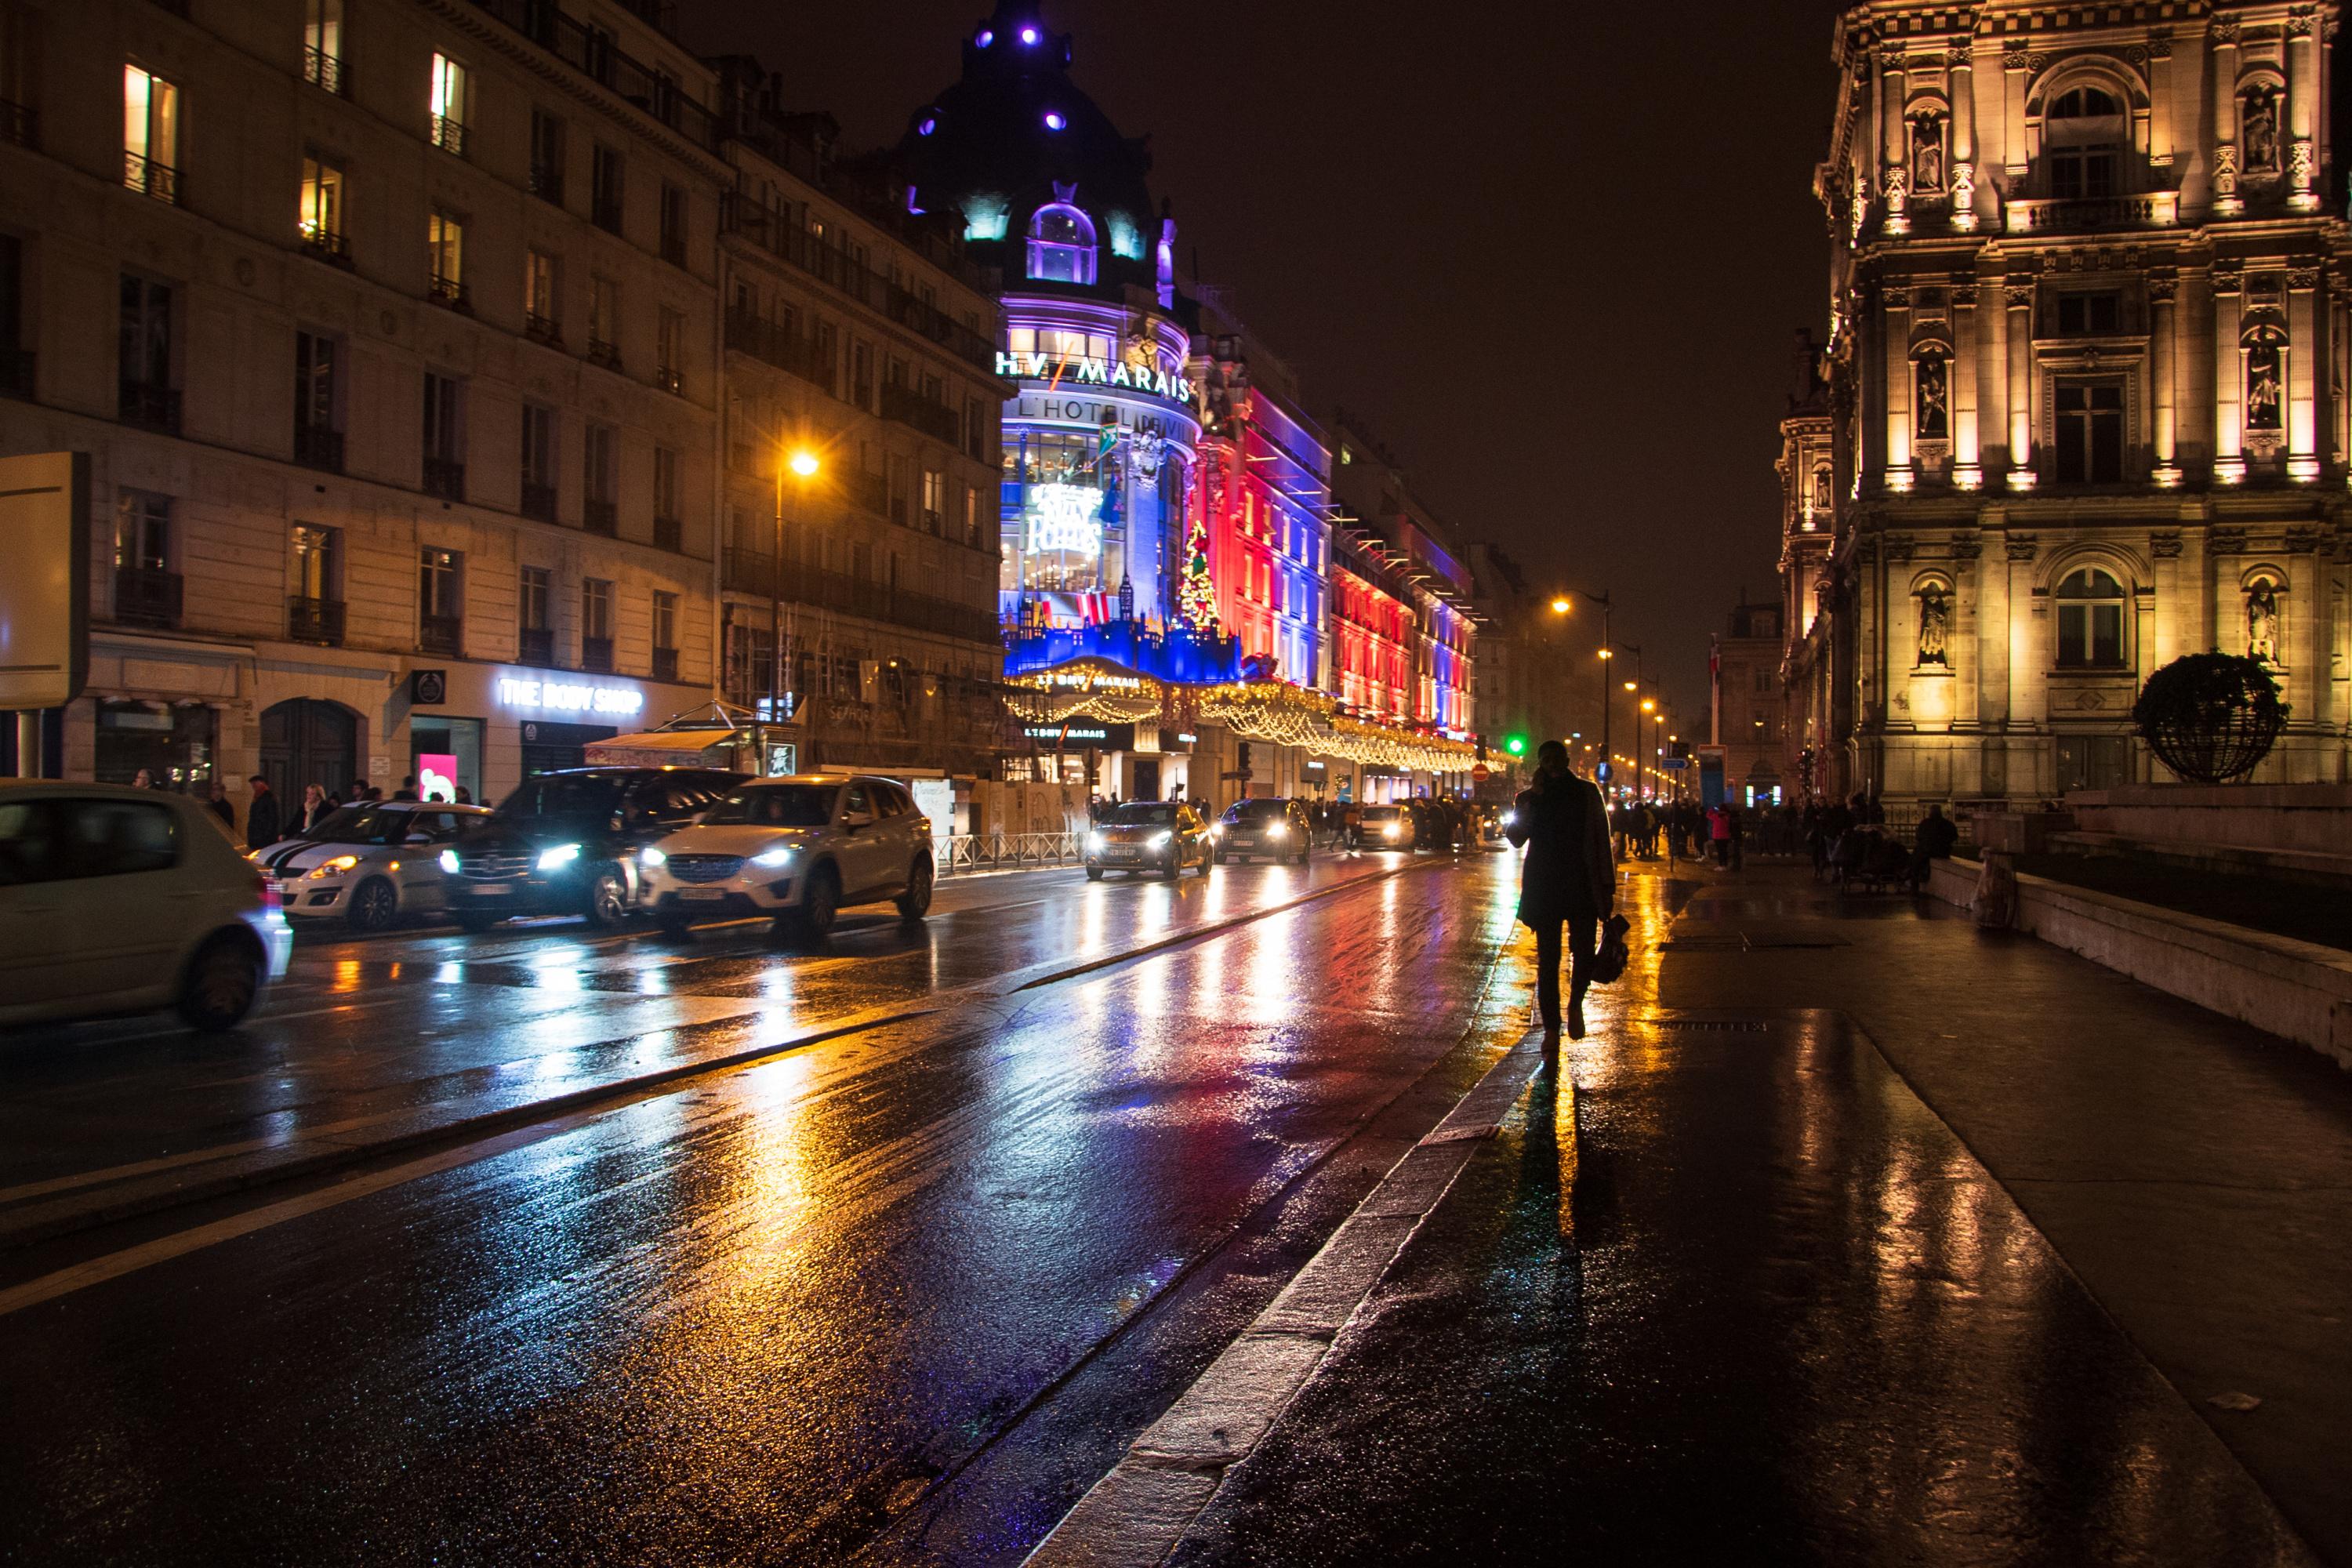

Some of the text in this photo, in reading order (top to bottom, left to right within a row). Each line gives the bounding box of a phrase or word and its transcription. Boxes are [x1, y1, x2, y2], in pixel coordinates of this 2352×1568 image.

[1077, 357, 1190, 402] MARAIS
[1093, 676, 1140, 688] MARAIS
[500, 679, 643, 714] THE BODY SHOP
[1065, 728, 1106, 739] MARAIS
